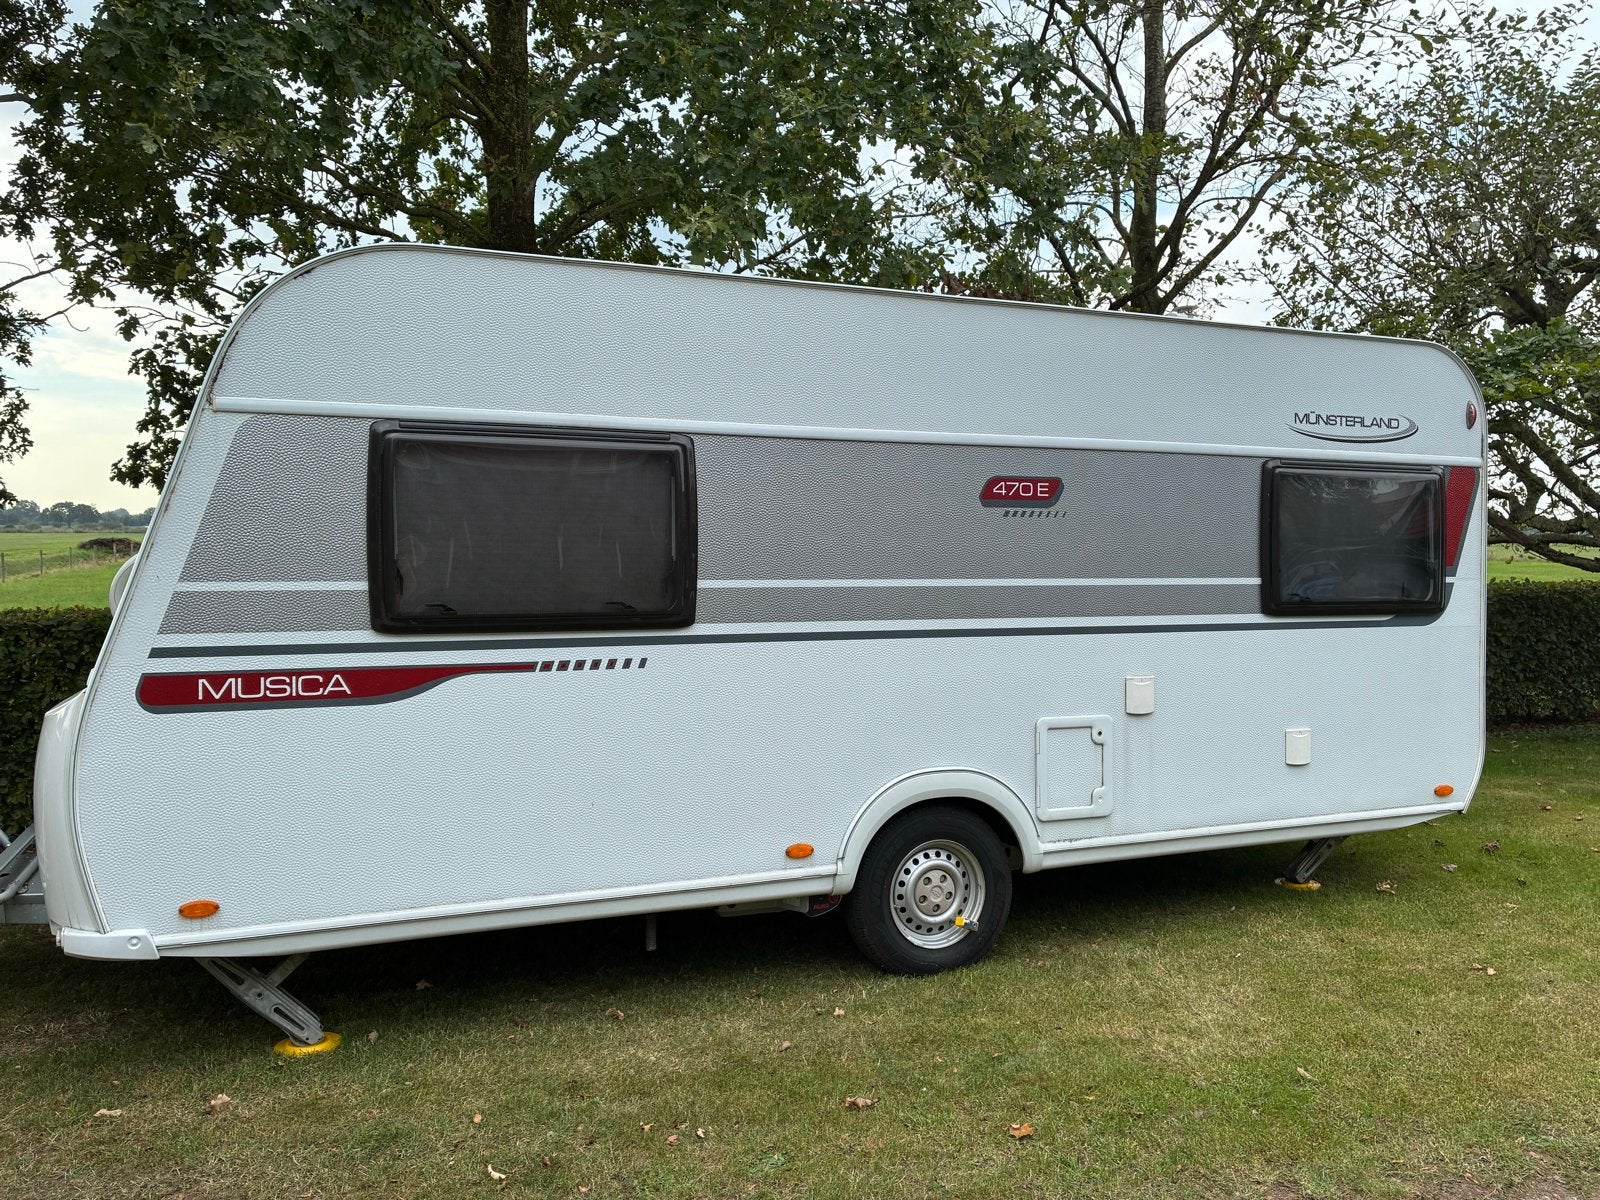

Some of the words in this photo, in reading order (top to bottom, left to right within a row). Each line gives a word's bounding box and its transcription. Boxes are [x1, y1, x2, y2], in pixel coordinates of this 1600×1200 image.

[1294, 411, 1400, 429] MÜNSTERLAND
[993, 481, 1033, 496] 470
[1037, 482, 1049, 497] E
[198, 674, 352, 700] MUSICA
